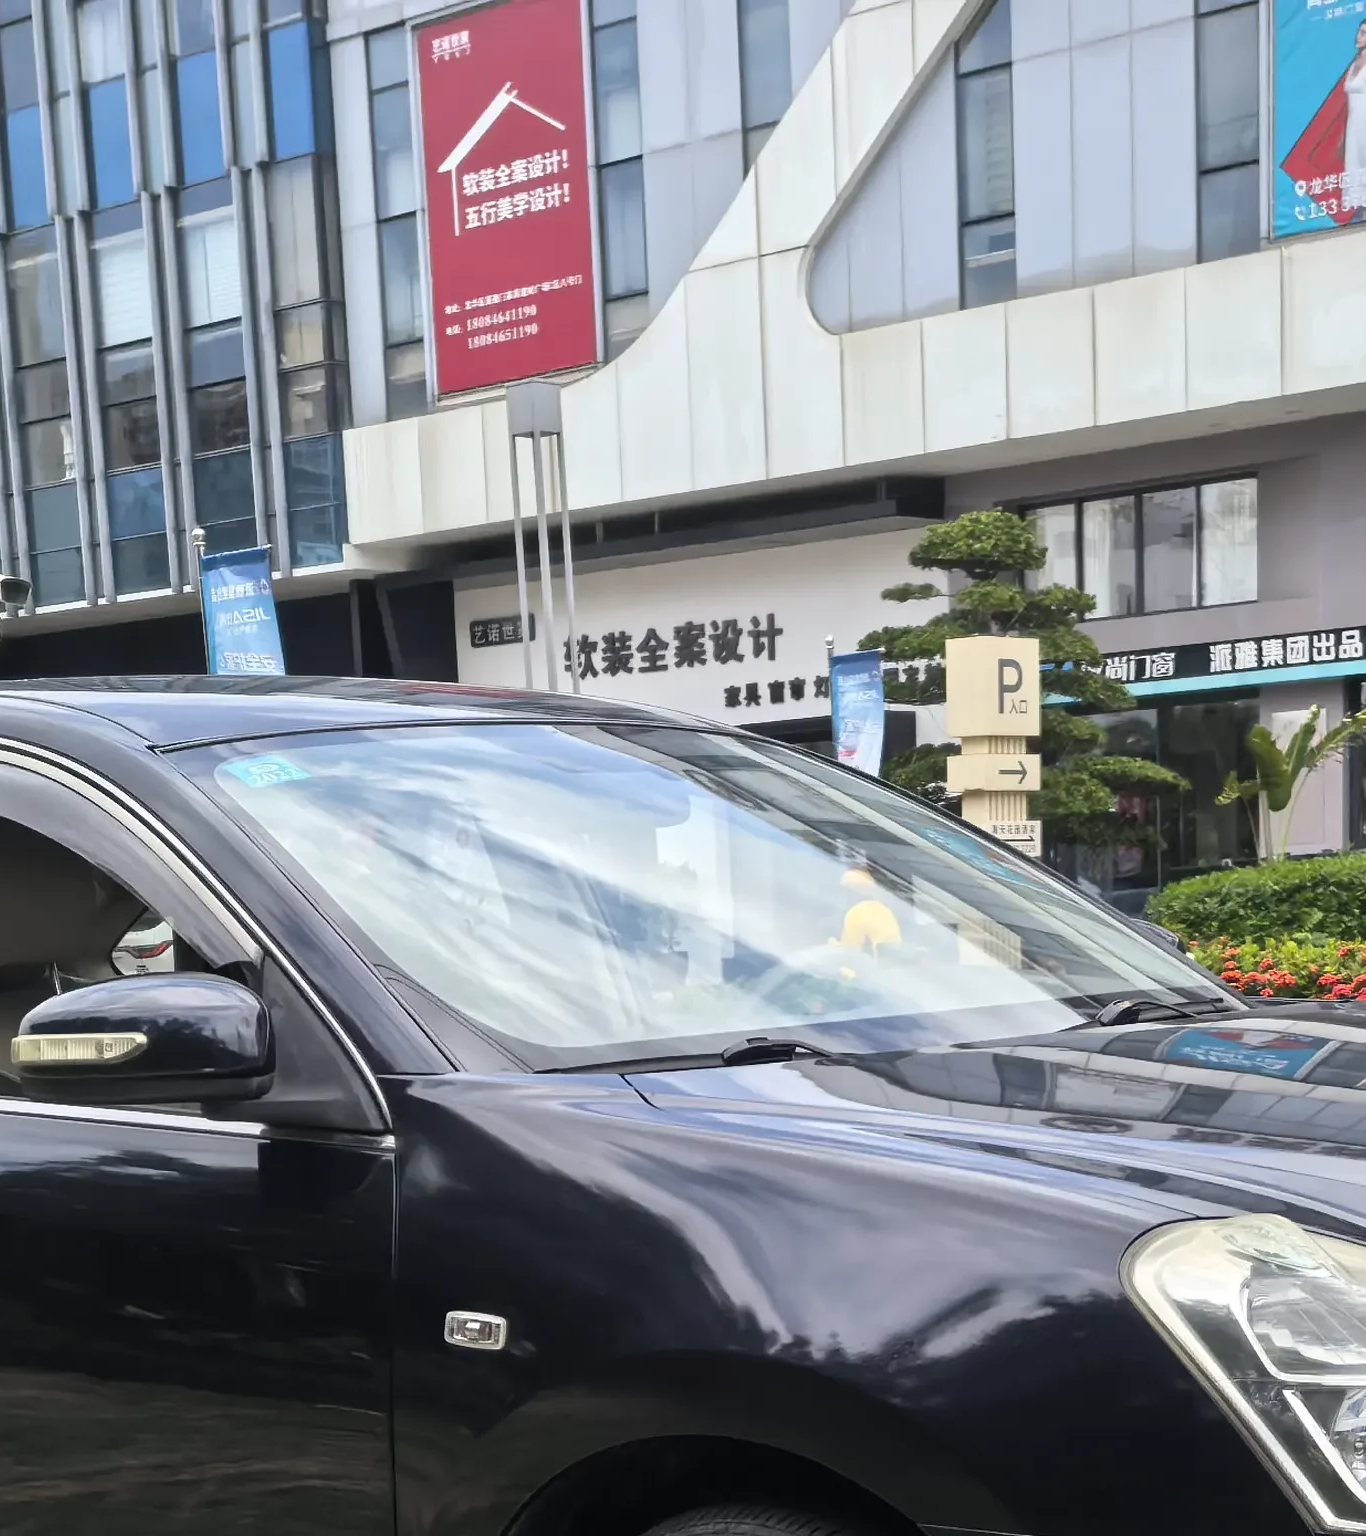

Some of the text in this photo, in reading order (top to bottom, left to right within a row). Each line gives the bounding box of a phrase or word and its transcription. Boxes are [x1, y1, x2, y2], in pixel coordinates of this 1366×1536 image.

[464, 183, 571, 229] 五行美学设计!
[563, 613, 783, 680] 软装全案设计
[1209, 629, 1363, 673] 派雅集团出品
[997, 658, 1023, 714] P
[1009, 699, 1028, 714] 入口
